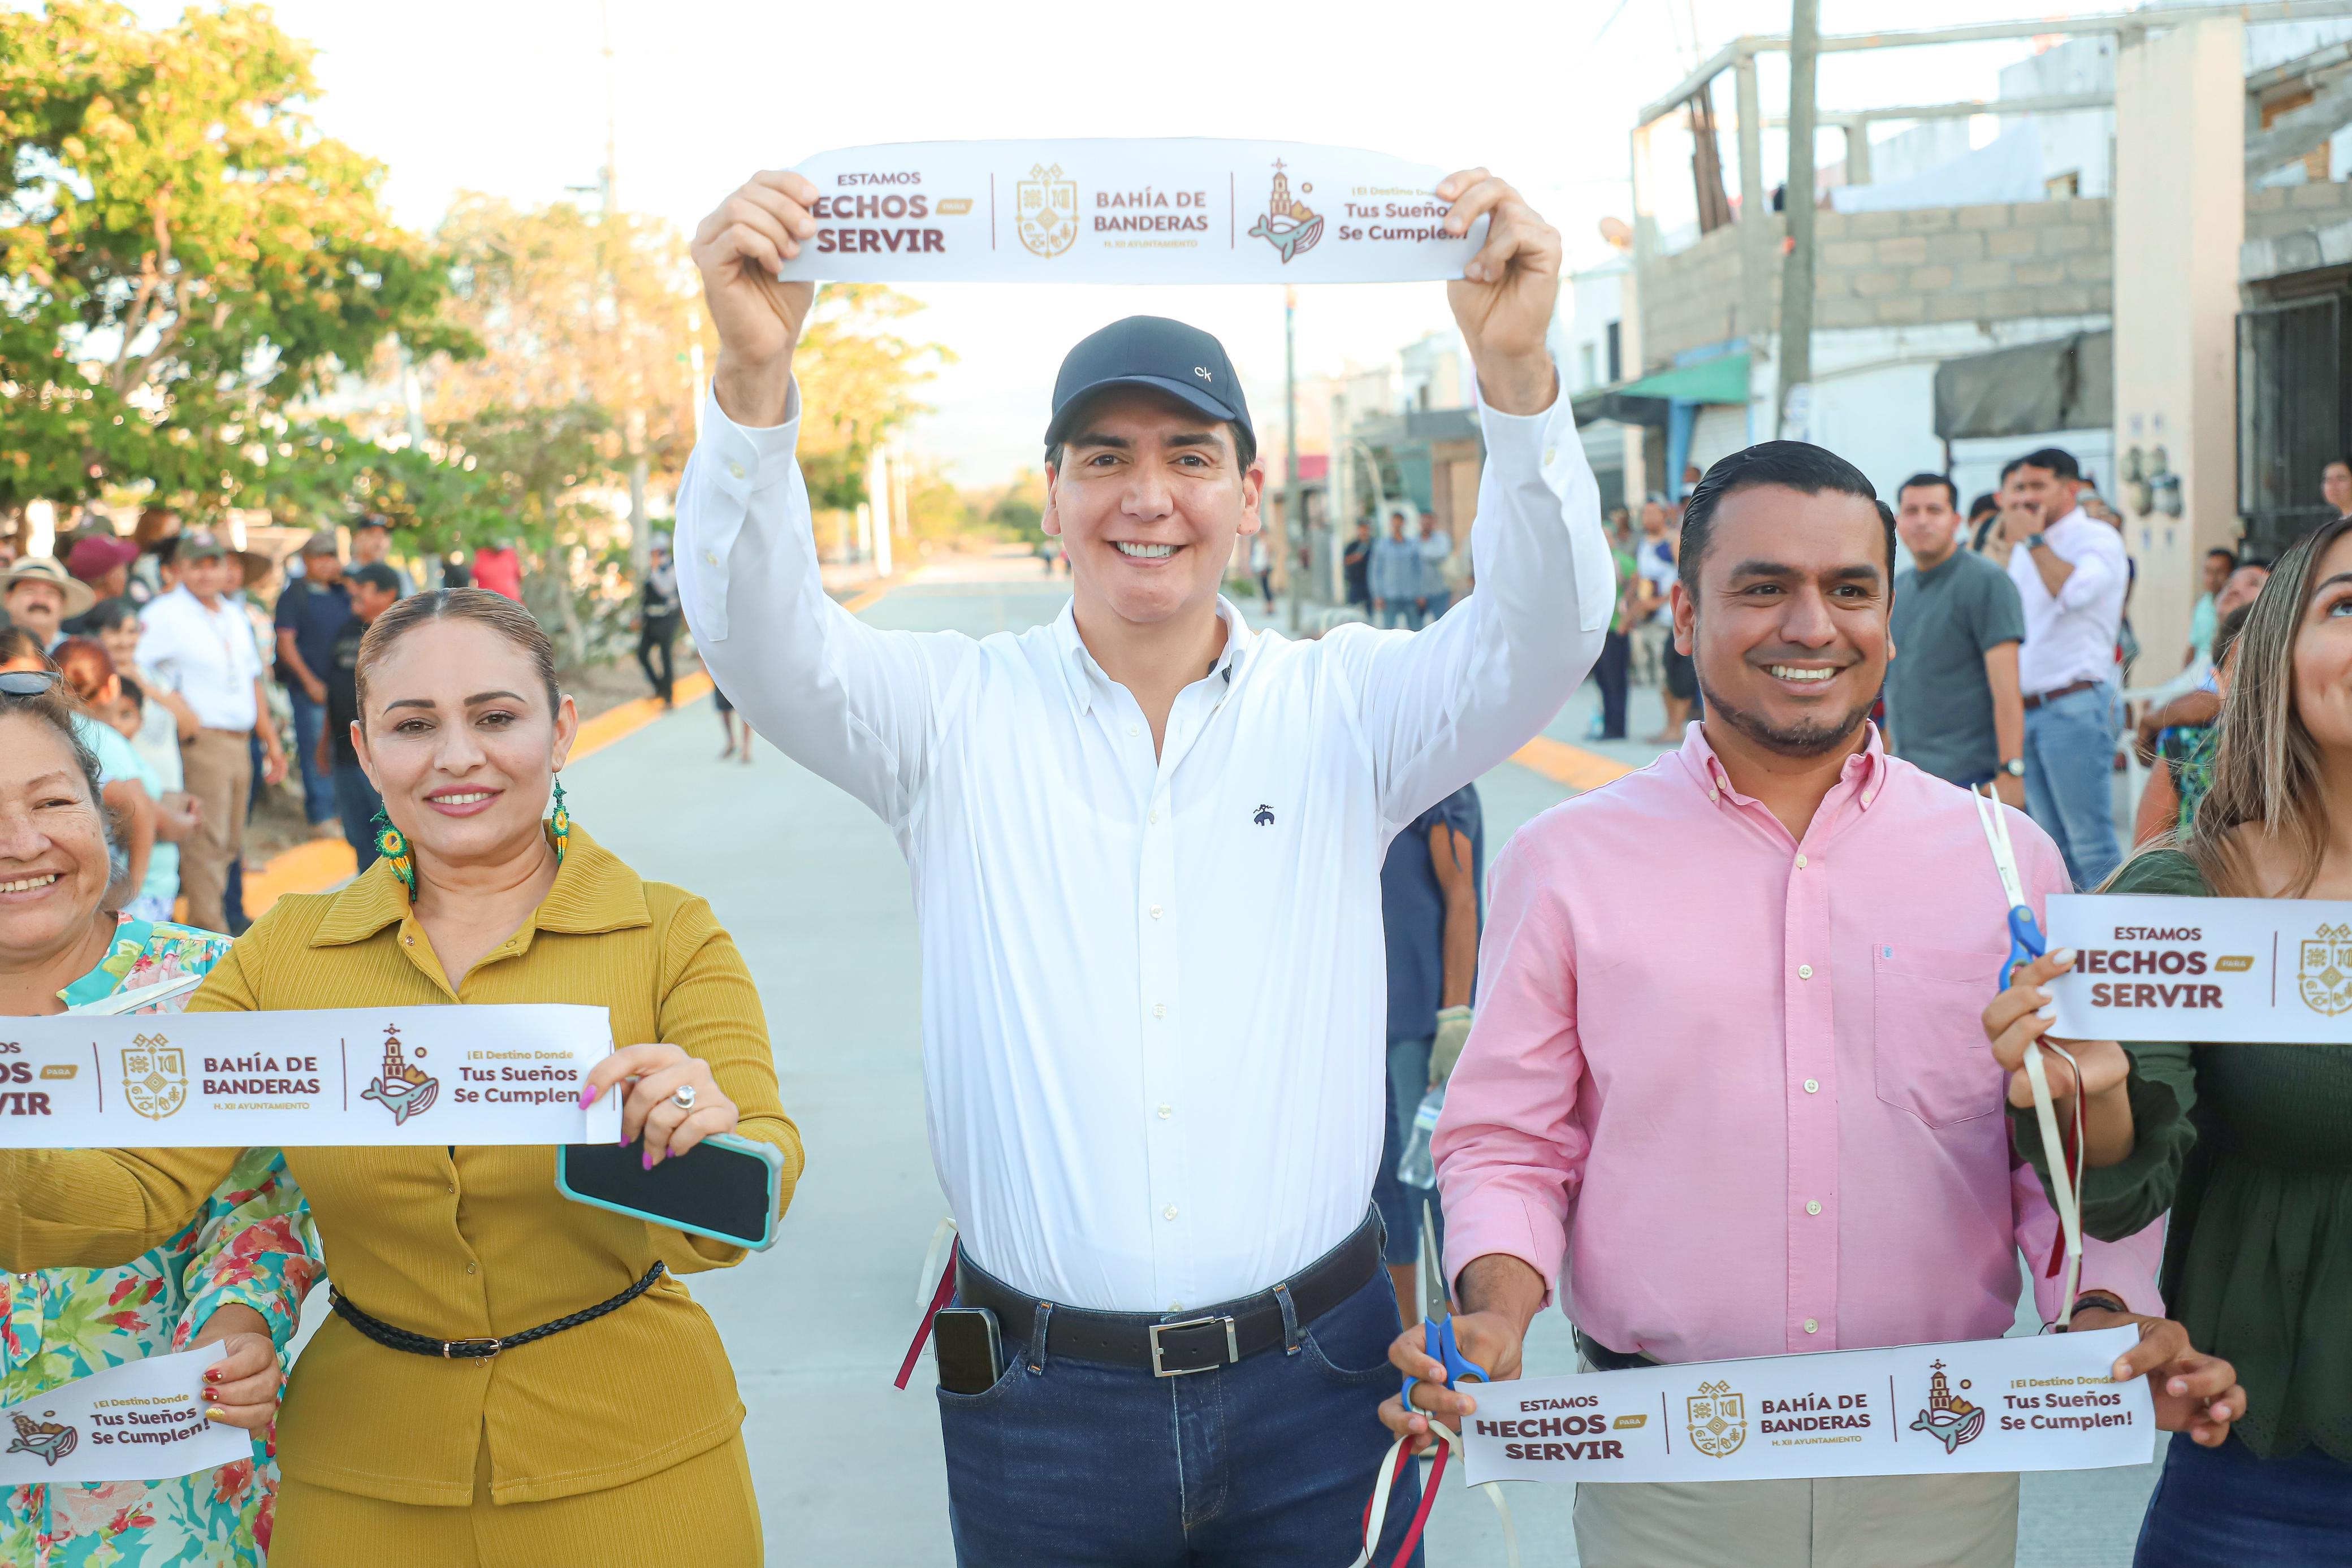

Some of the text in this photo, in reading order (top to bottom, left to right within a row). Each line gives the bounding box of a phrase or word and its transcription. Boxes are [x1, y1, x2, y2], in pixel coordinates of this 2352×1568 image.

[838, 172, 921, 186] ESTAMOS
[1096, 186, 1205, 208] BAHÍA DE
[808, 195, 928, 219] ECHOS
[1344, 202, 1451, 218] Tus Sueño
[1095, 215, 1208, 231] BANDERAS
[817, 229, 945, 253] SERVIR
[1339, 226, 1467, 242] Se Cumple!
[2115, 927, 2202, 941] ESTAMOS
[2091, 983, 2223, 1008] SERVIR
[204, 1052, 317, 1072] BAHÍA DE
[487, 1050, 531, 1059] Destino
[535, 1050, 573, 1059] Donde
[459, 1065, 578, 1081] Tus Sueños
[203, 1078, 321, 1094] BANDERAS
[454, 1087, 581, 1105] Se Cumplen
[2030, 1376, 2074, 1387] Destino
[2077, 1375, 2116, 1385] Donde
[111, 1397, 150, 1407] Destino
[153, 1393, 189, 1404] Donde
[1520, 1396, 1598, 1412] ESTAMOS
[1762, 1392, 1867, 1414] BAHÍA DE
[2004, 1391, 2121, 1409] Tus Sueños
[90, 1407, 197, 1426] Tus Sueños
[1476, 1414, 1606, 1437] HECHOS
[1761, 1414, 1871, 1433] BANDERAS
[2000, 1411, 2132, 1431] Se Cumplen!
[92, 1418, 210, 1445] Se Cumplen!
[1794, 1435, 1862, 1445] AYUNTAMIENTO
[1505, 1440, 1624, 1460] SERVIR
